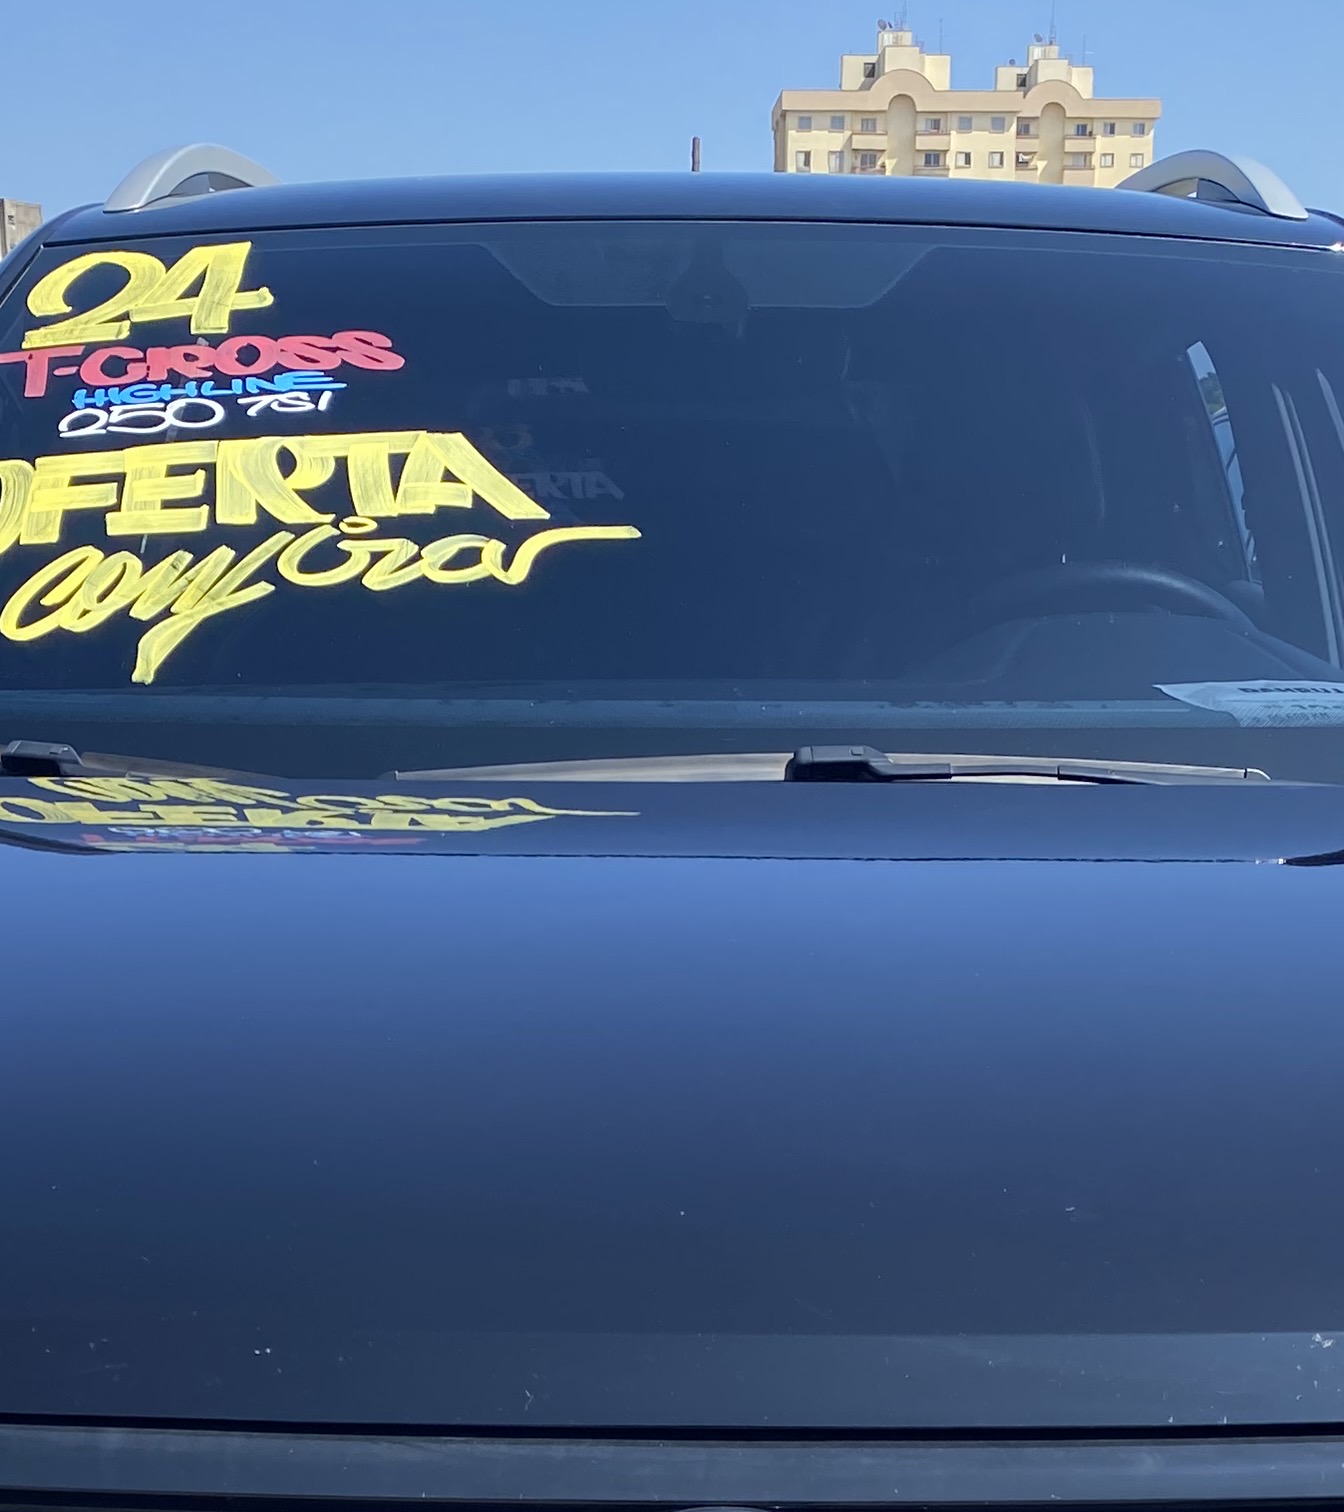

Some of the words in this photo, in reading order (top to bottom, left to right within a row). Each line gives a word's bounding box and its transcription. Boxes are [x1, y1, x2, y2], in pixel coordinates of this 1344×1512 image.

[20, 240, 275, 348] 24
[71, 370, 348, 409] HIGHLINE
[57, 398, 226, 438] 250
